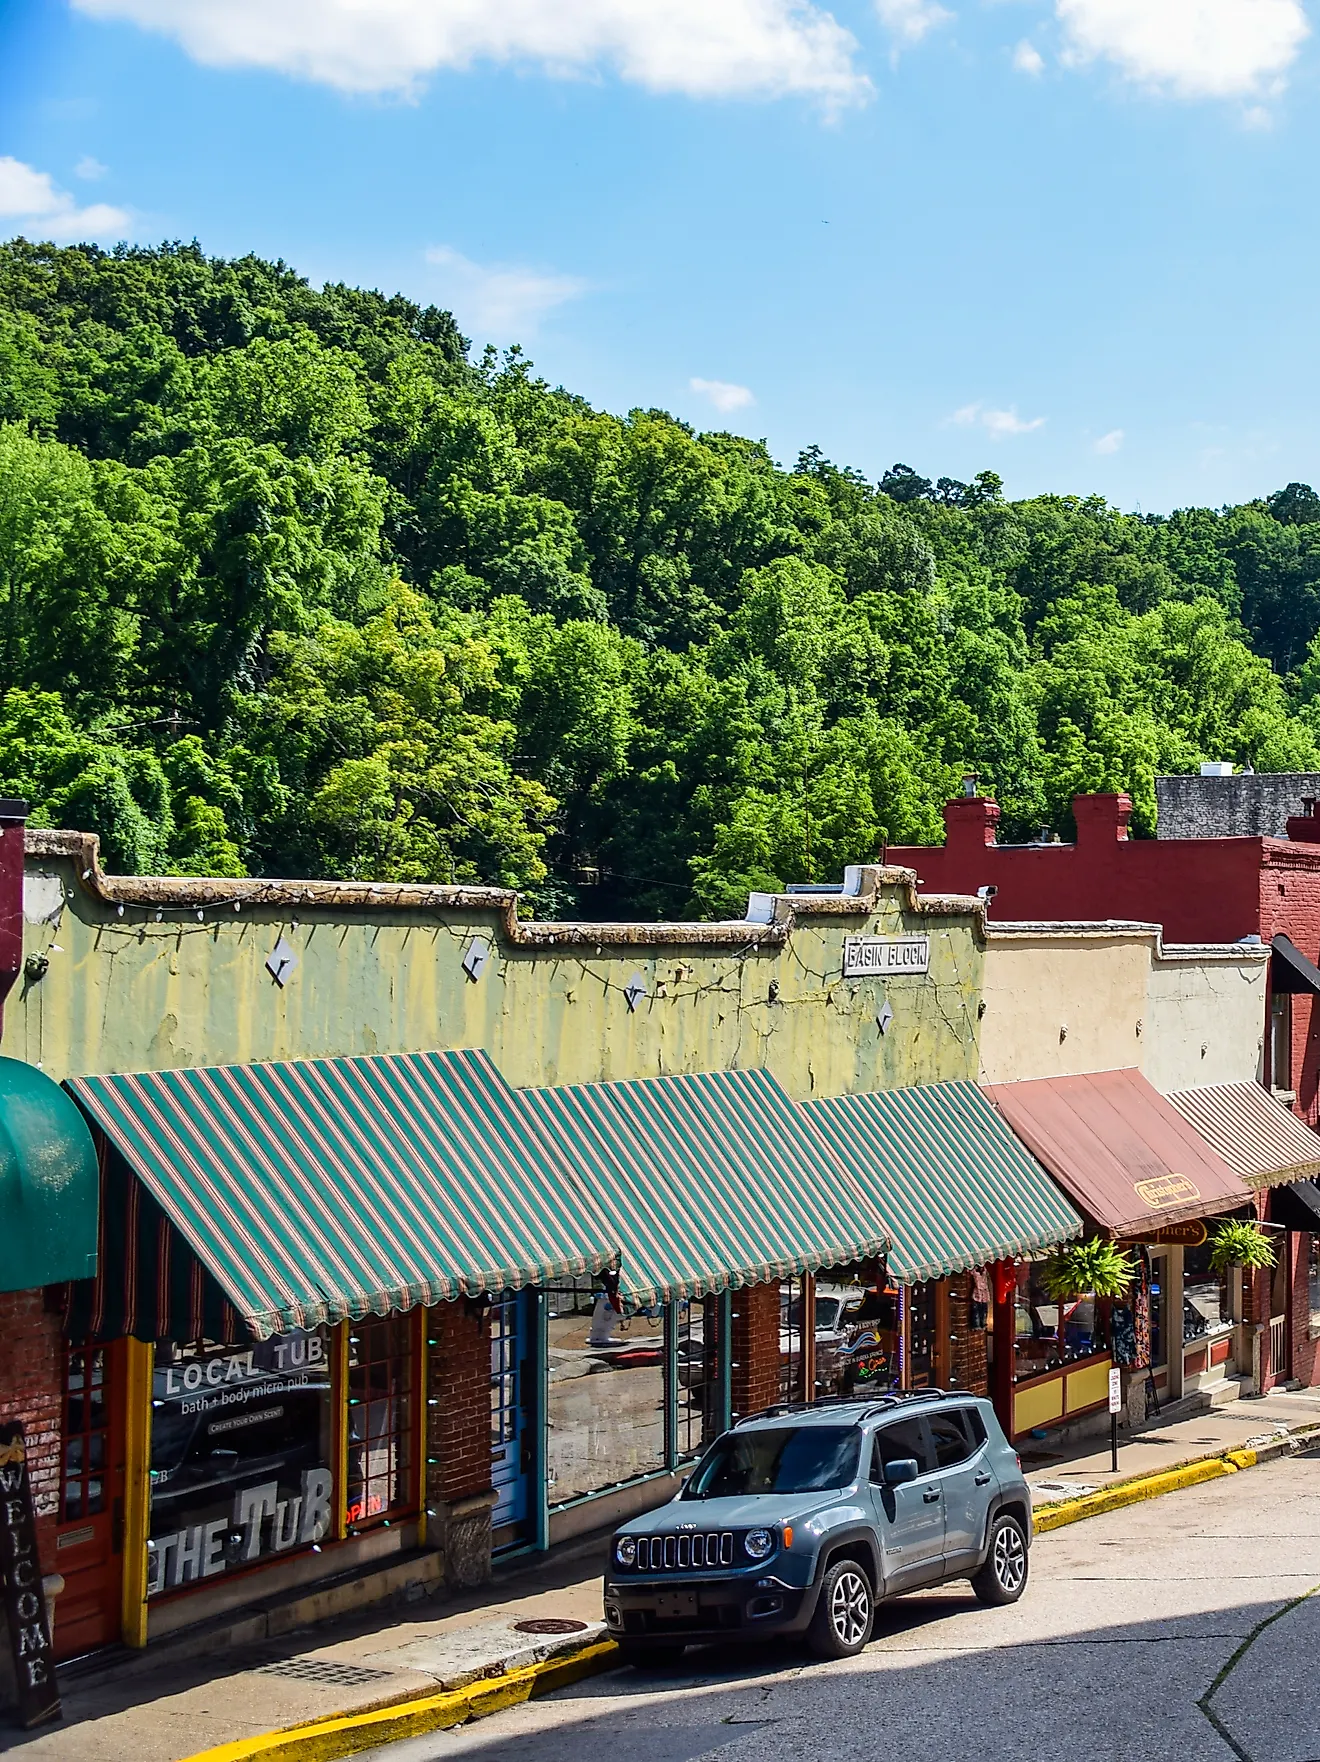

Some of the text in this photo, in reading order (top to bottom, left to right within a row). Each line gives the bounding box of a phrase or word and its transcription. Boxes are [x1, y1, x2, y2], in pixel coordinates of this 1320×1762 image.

[847, 945, 926, 967] BASIN BLOCK
[166, 1336, 323, 1394] LOCAL TUB
[181, 1397, 209, 1415] bath
[221, 1390, 249, 1405] body
[252, 1382, 284, 1398] micro
[287, 1373, 309, 1392] pub
[148, 1467, 333, 1593] THE TUB
[0, 1463, 48, 1686] WELCOME
